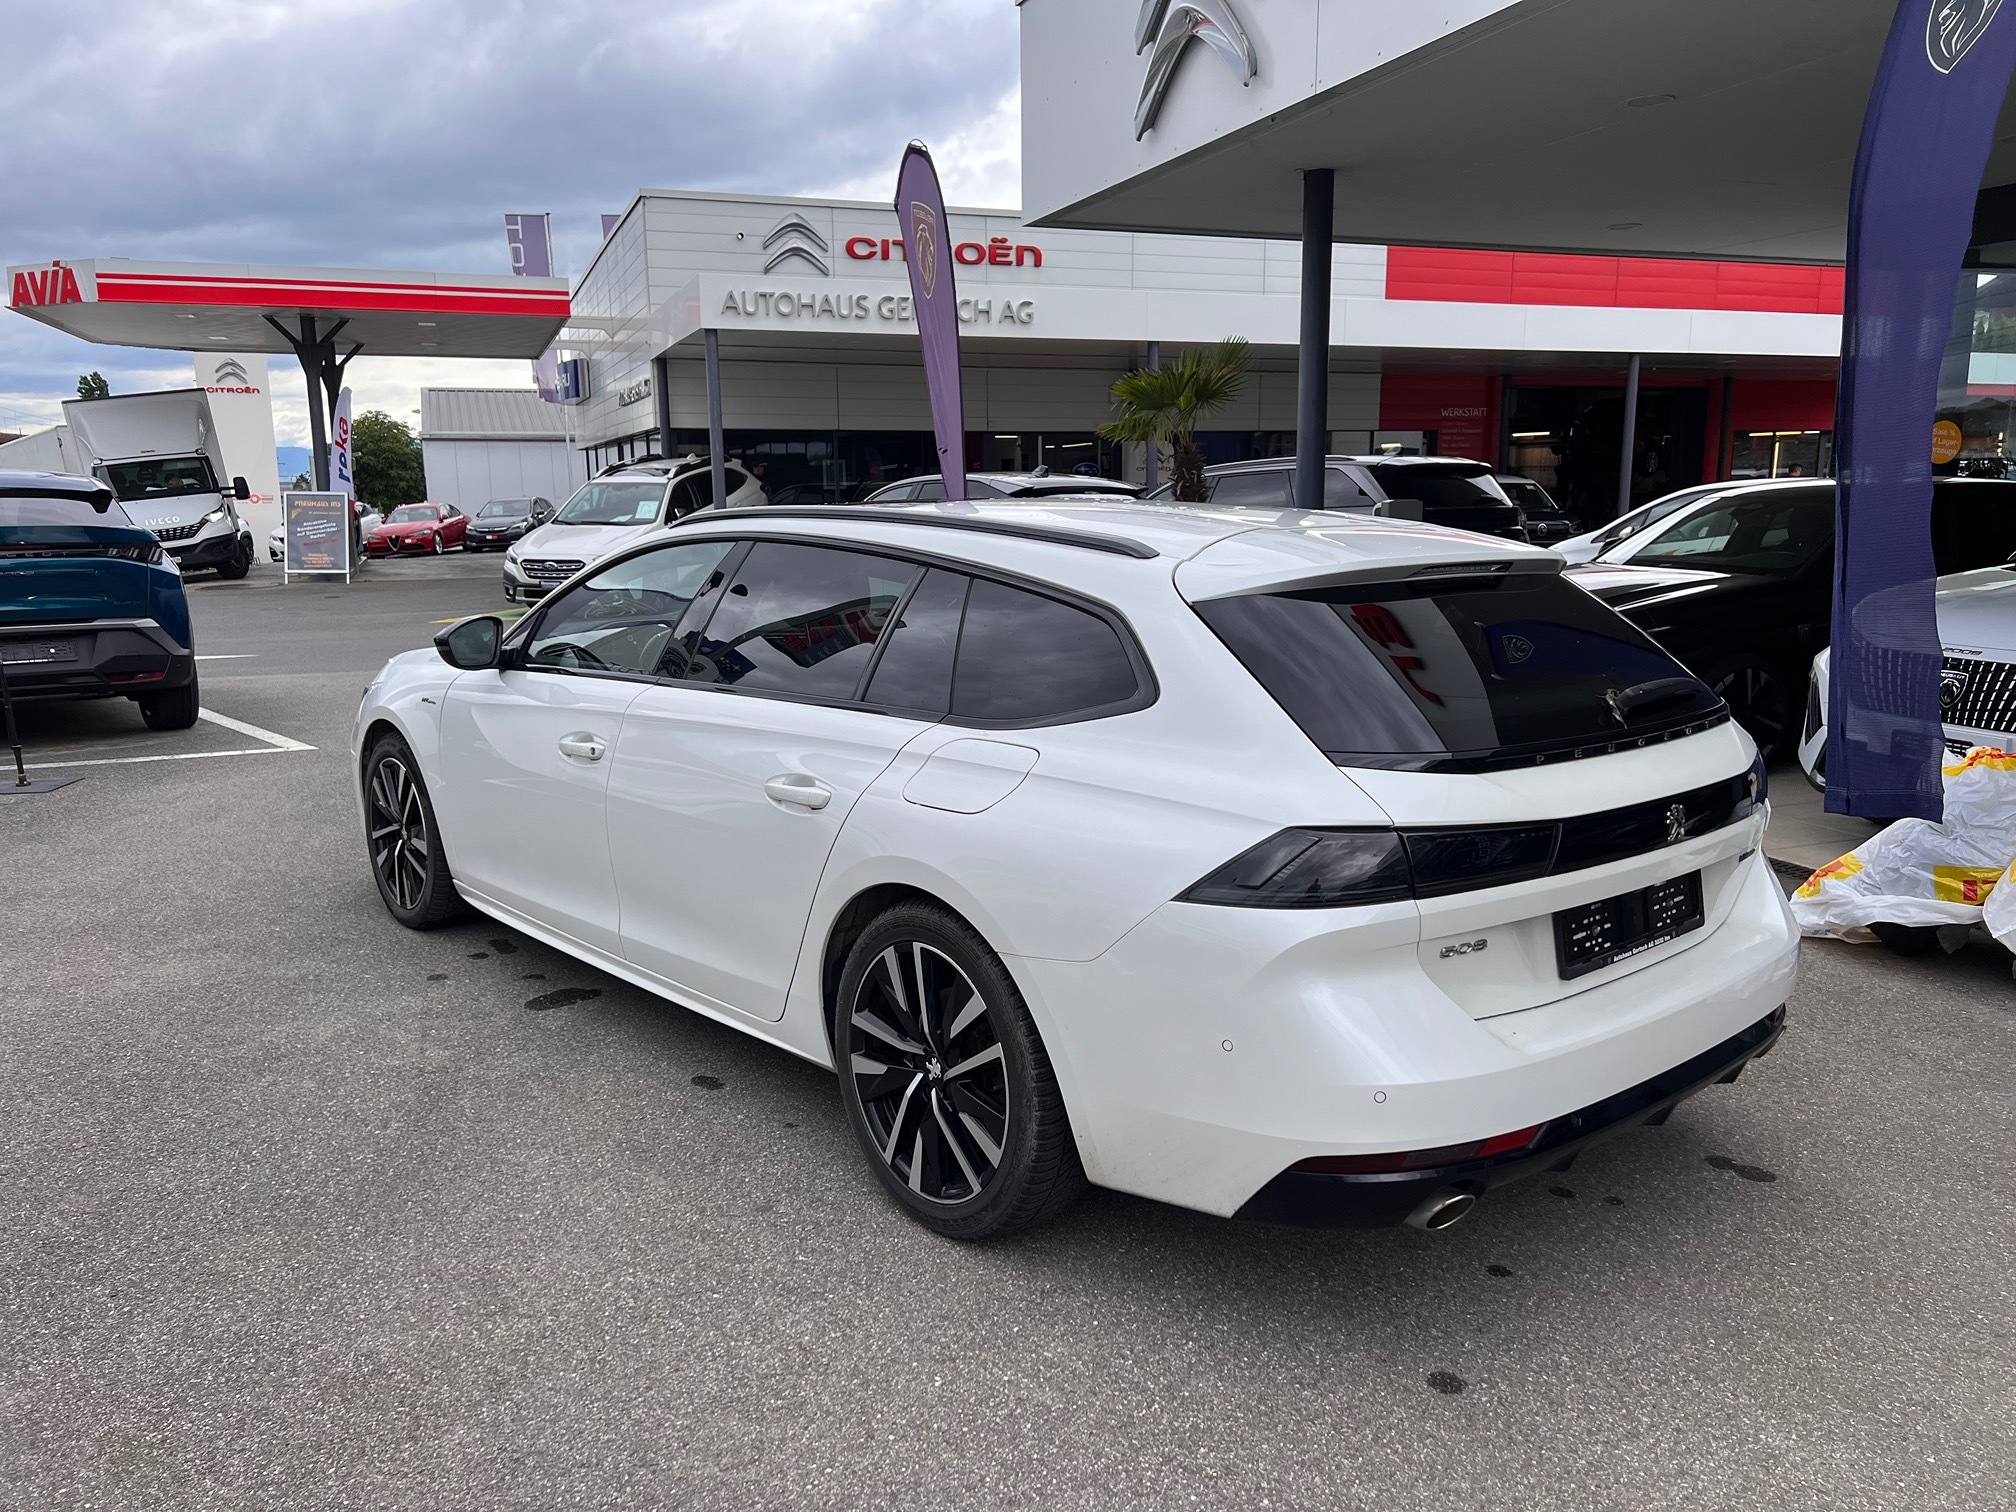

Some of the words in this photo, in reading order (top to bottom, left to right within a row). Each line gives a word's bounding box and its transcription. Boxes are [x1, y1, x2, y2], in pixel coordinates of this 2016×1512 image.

[12, 260, 83, 307] AVIA
[721, 289, 871, 320] AUTOHAUS
[877, 295, 993, 324] GECH
[999, 299, 1035, 324] AG
[1441, 407, 1488, 417] WERKSTATT
[1933, 427, 1948, 435] Sale
[335, 416, 351, 483] reka
[145, 516, 181, 526] IVECO
[1942, 647, 1983, 656] 2008
[1536, 720, 1711, 765] PEUGEOT
[1439, 938, 1488, 959] 508
[1613, 950, 1632, 962] Autohaus
